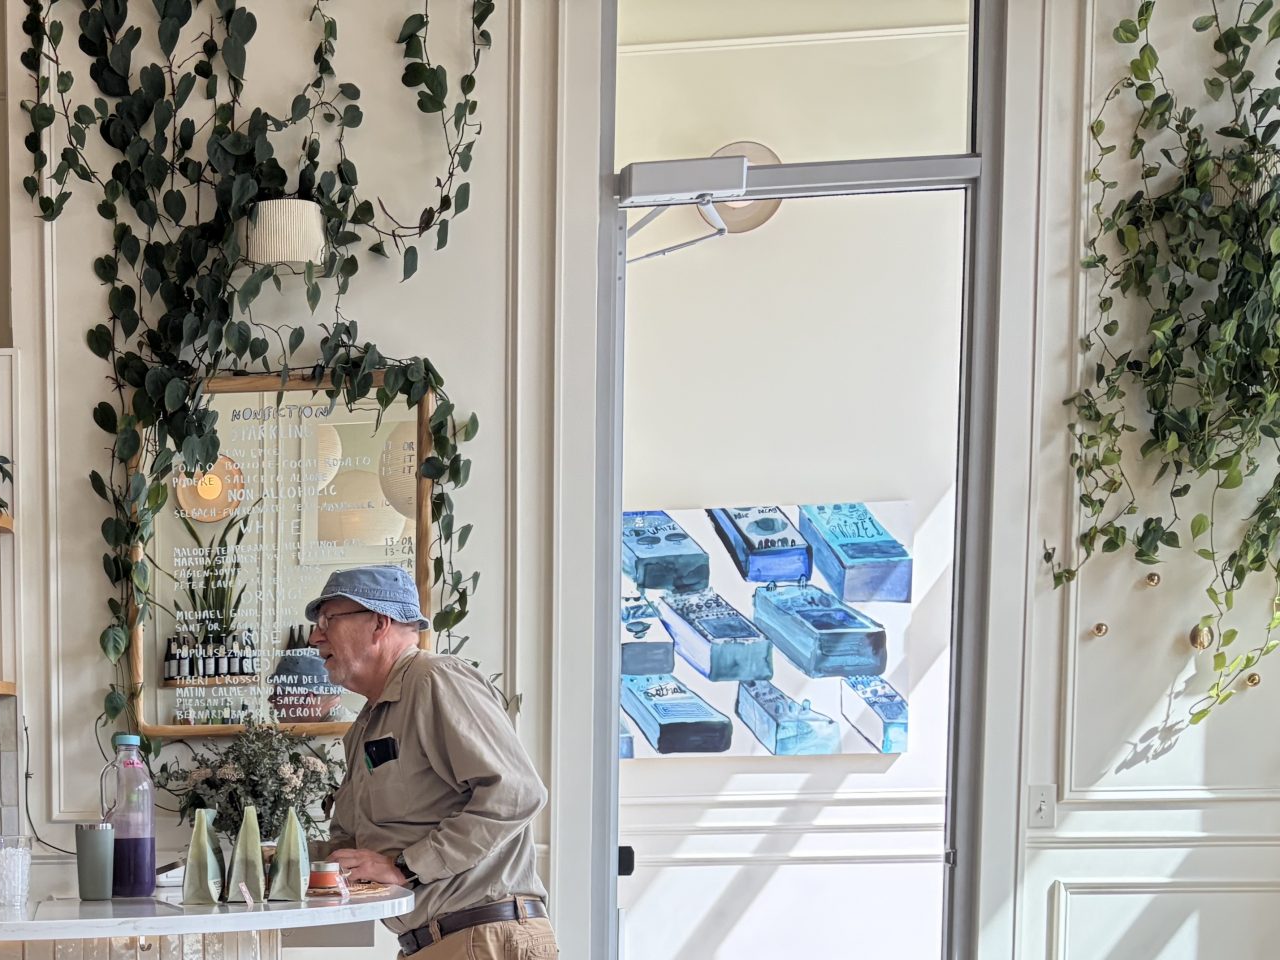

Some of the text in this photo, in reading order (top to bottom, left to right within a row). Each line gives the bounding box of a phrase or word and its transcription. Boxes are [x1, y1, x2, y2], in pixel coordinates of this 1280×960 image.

[231, 405, 329, 421] NONFICTION
[227, 485, 337, 502] NON ALCOHOLIC
[240, 519, 302, 534] WHITE
[174, 556, 211, 567] MARTHA
[174, 581, 207, 590] PETER
[176, 608, 224, 620] MICHAEL
[242, 658, 270, 673] RED
[173, 675, 209, 686] TIBERI
[266, 674, 299, 684] GAMAY
[302, 674, 319, 684] DEL
[176, 686, 206, 698] MATIN
[176, 709, 224, 720] BERNARD
[288, 707, 322, 718] CROIX
